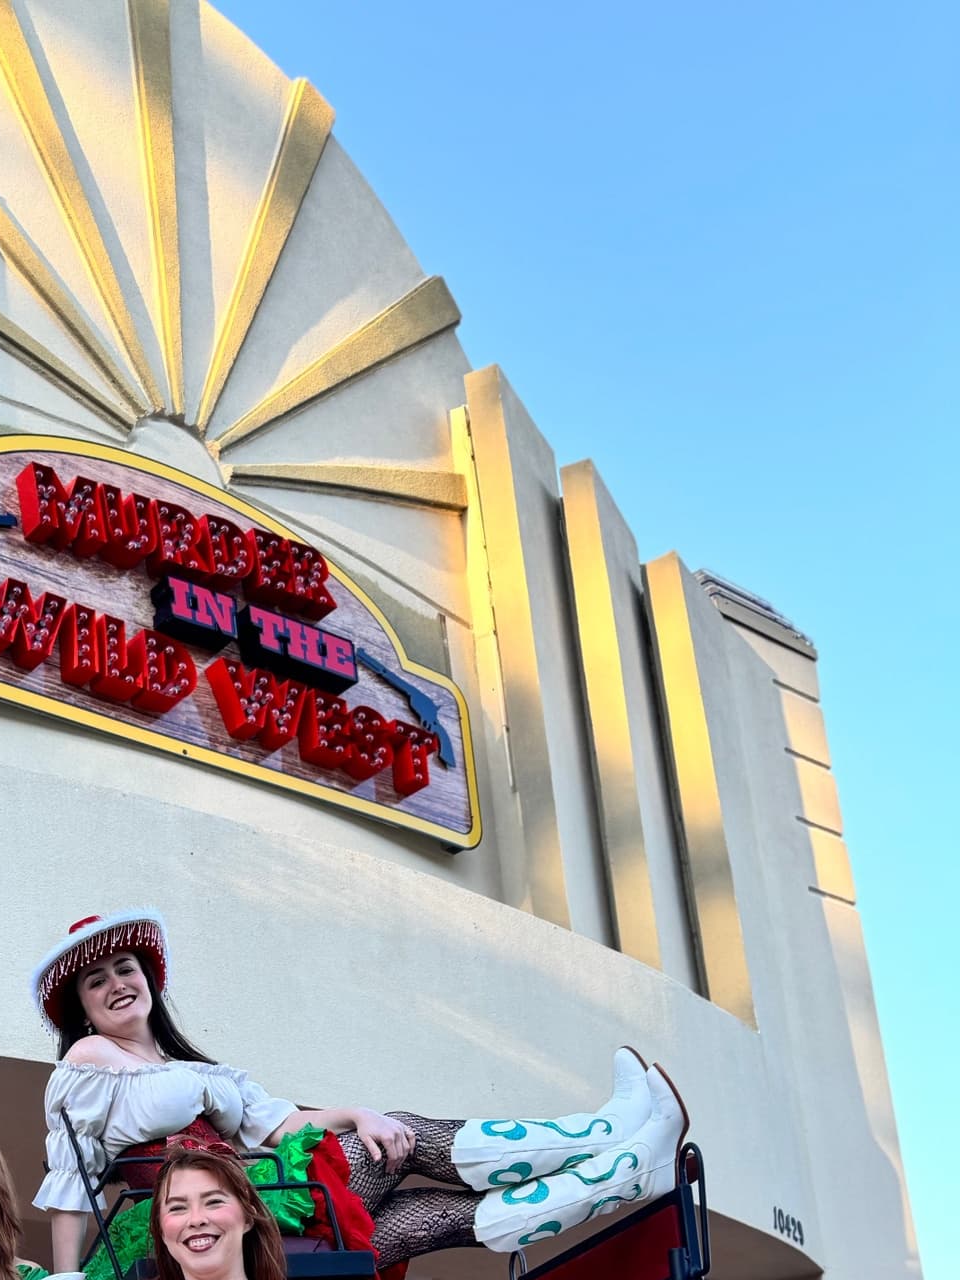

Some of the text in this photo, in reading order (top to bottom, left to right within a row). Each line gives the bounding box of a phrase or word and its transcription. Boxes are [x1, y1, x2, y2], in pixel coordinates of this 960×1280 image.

[16, 461, 337, 621] MURDER
[164, 574, 358, 686] IN THE
[205, 656, 437, 796] WEST
